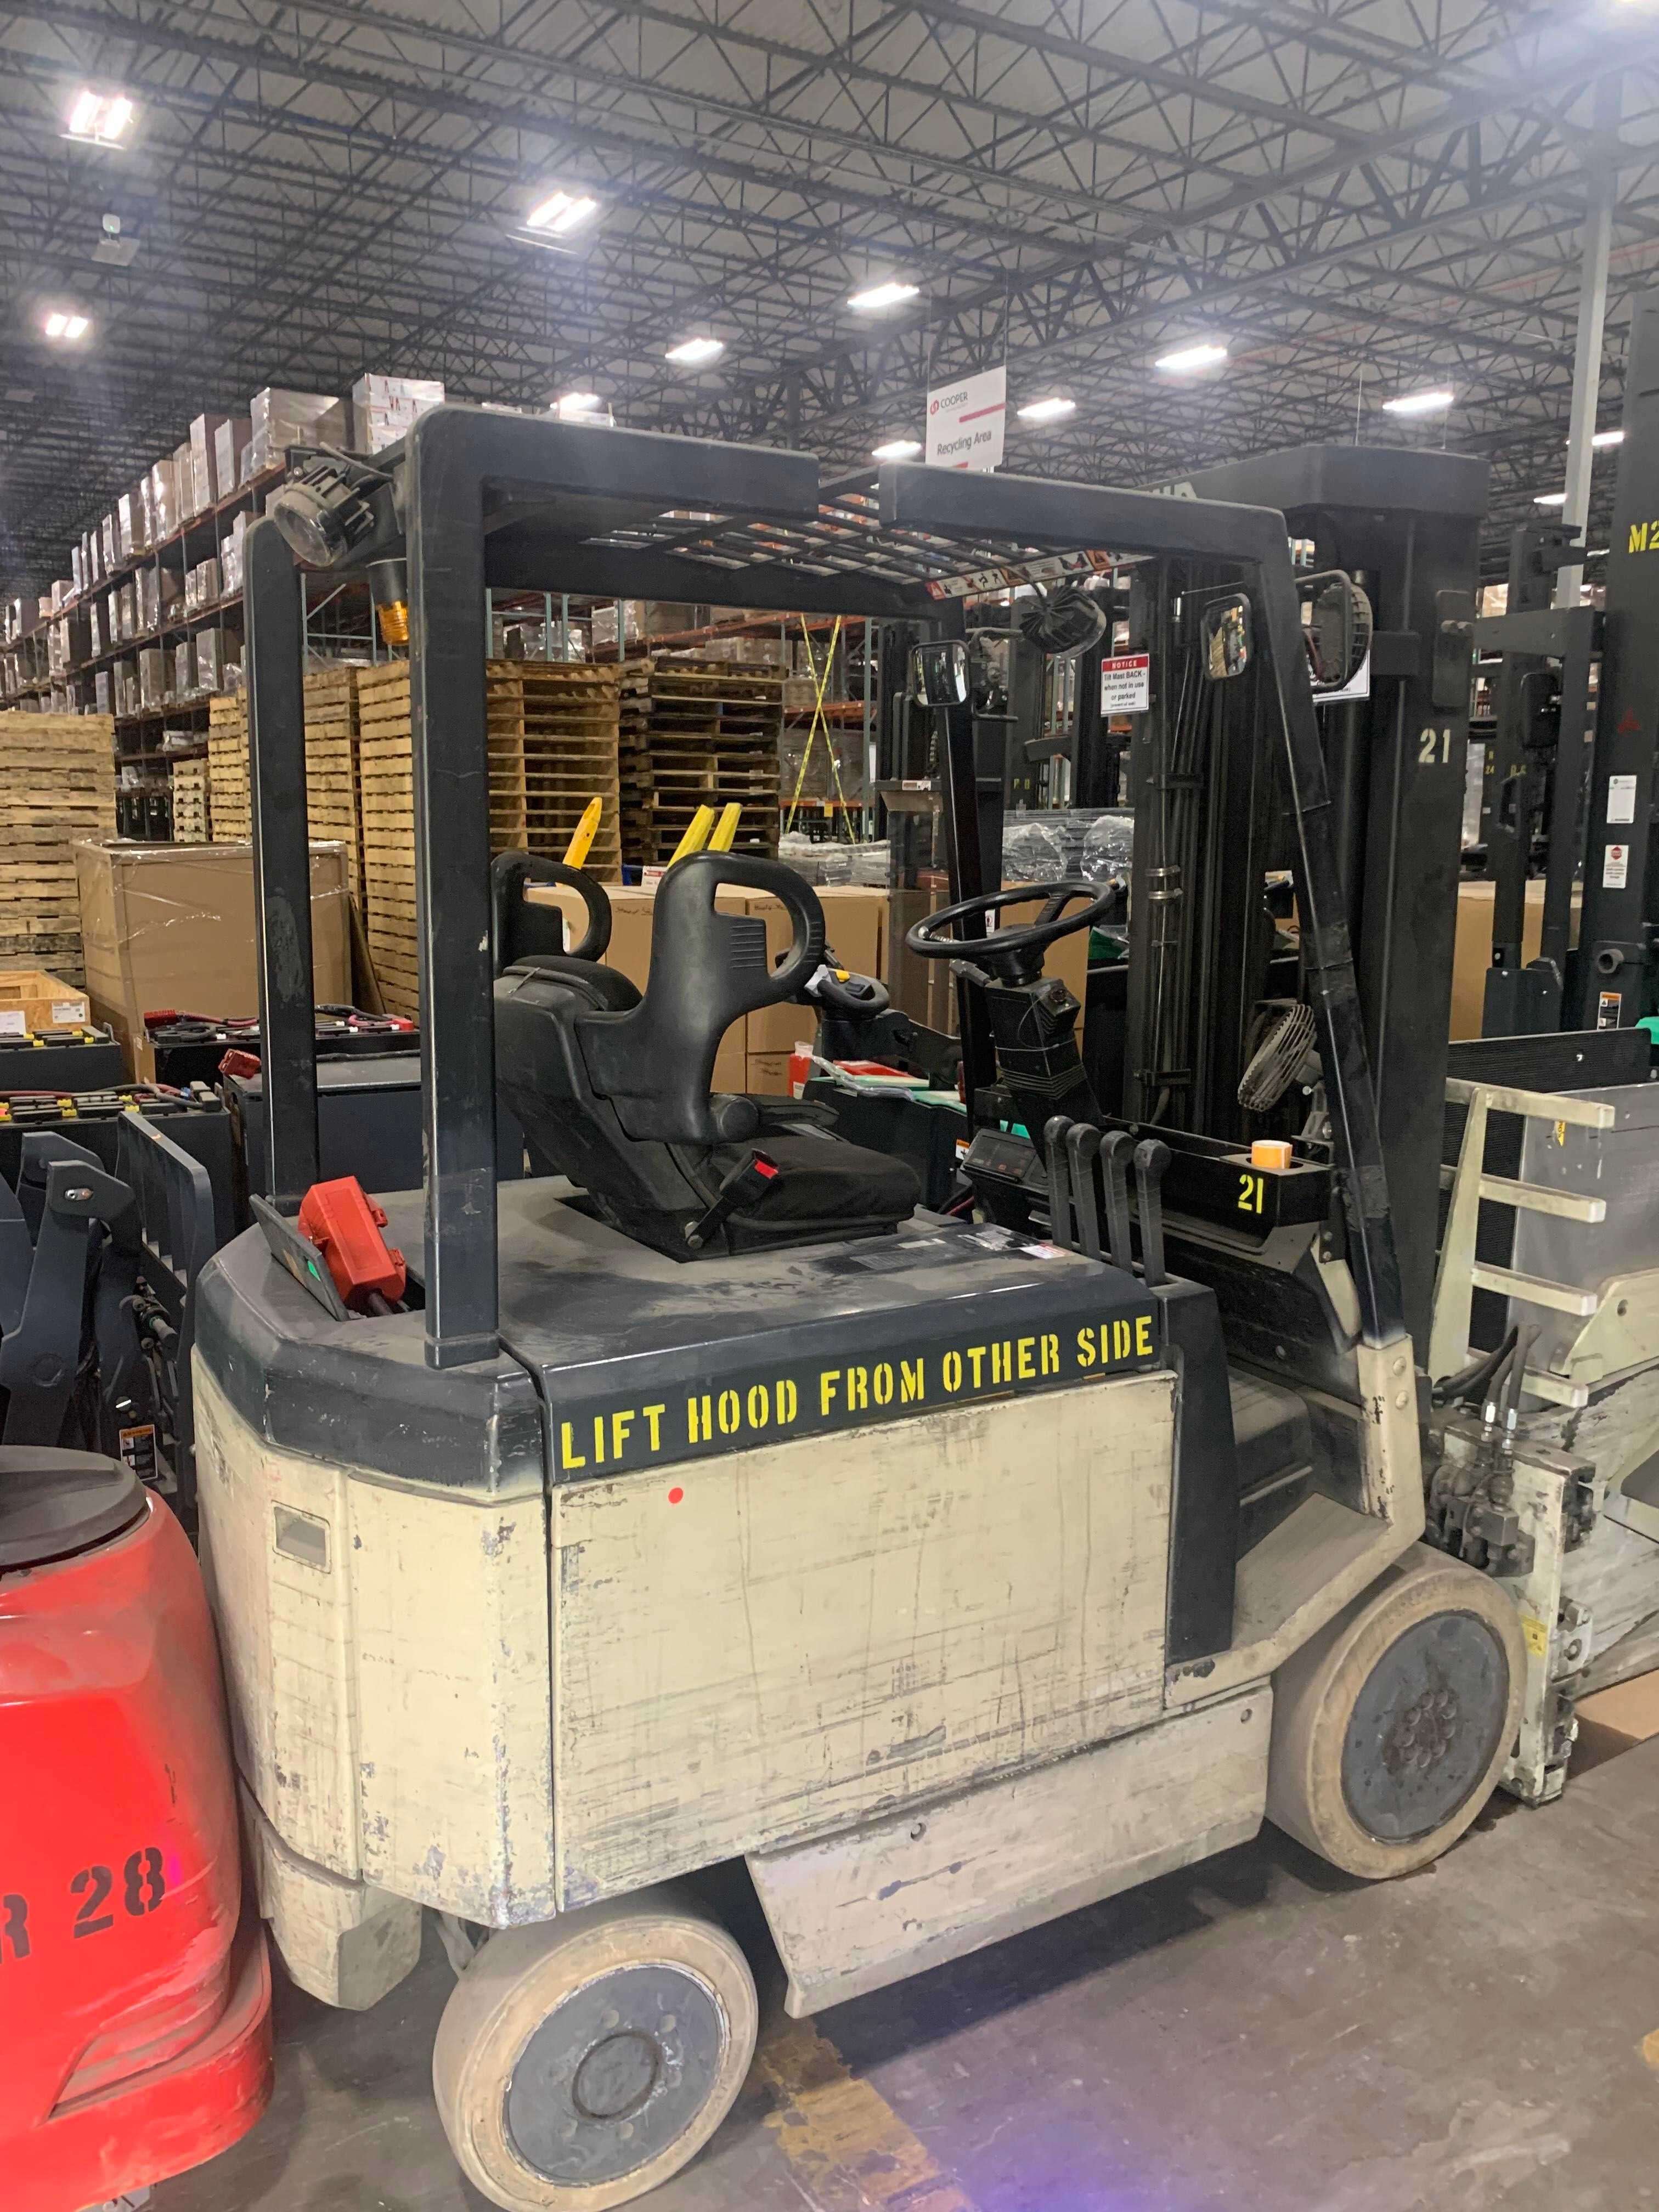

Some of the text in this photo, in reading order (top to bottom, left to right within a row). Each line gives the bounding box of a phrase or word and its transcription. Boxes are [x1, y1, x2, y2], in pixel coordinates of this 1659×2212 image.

[940, 392, 968, 409] COOPER
[937, 431, 991, 456] Recycling Area
[1112, 660, 1137, 669] NOTICE
[1118, 692, 1136, 701] parked
[1418, 728, 1451, 763] 21
[1238, 1174, 1263, 1214] 21
[561, 1316, 1153, 1470] LIFT HOOD FROM OTHER SIDE
[70, 1847, 166, 1939] 28
